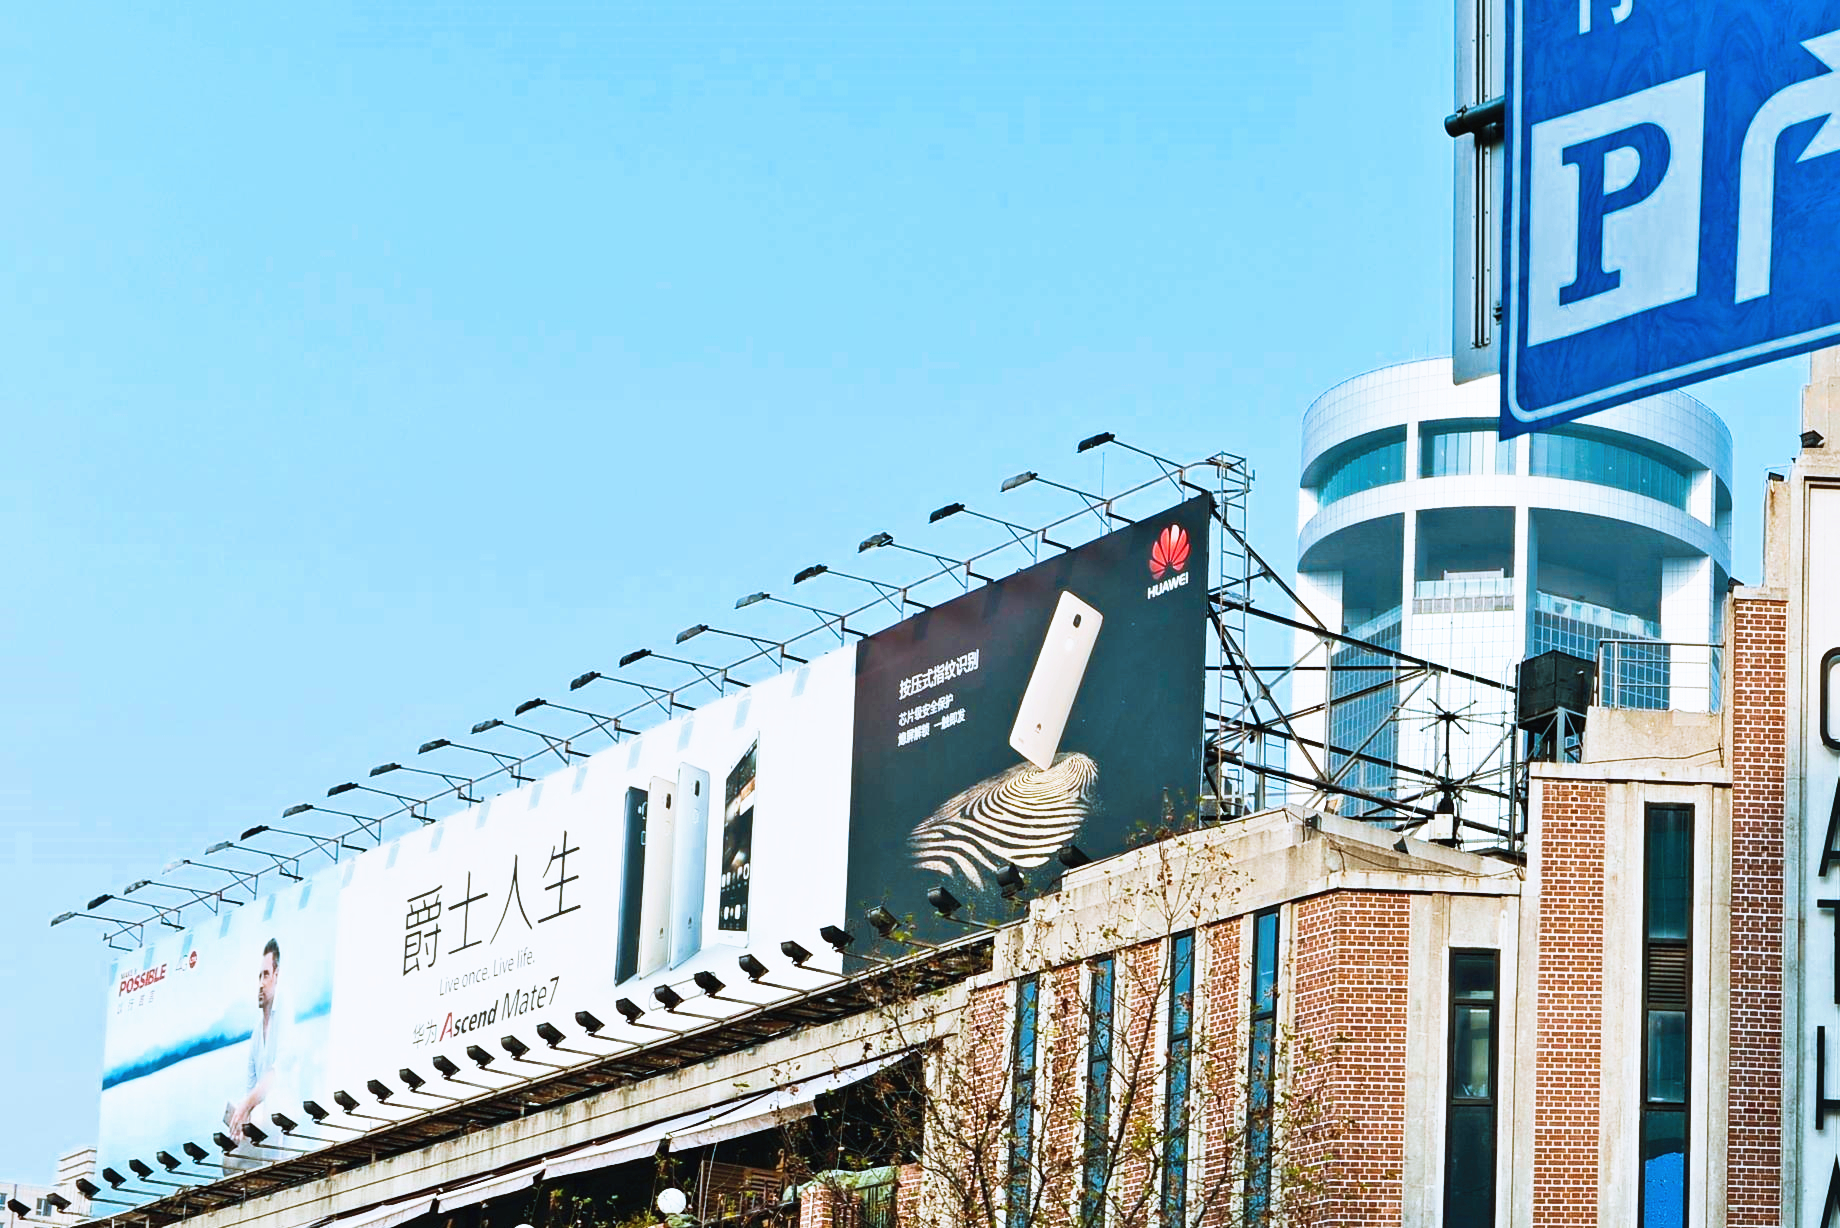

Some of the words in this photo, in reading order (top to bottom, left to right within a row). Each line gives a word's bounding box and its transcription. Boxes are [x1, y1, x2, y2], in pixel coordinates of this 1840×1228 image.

[1559, 122, 1672, 306] P
[1147, 571, 1189, 600] HUAWEI
[899, 648, 980, 701] 按压式指纹识别
[402, 830, 582, 977] 爵士人生
[118, 962, 168, 998] POSSIBLE
[439, 977, 460, 997] Live
[493, 957, 515, 977] Live
[439, 999, 499, 1042] Ascend
